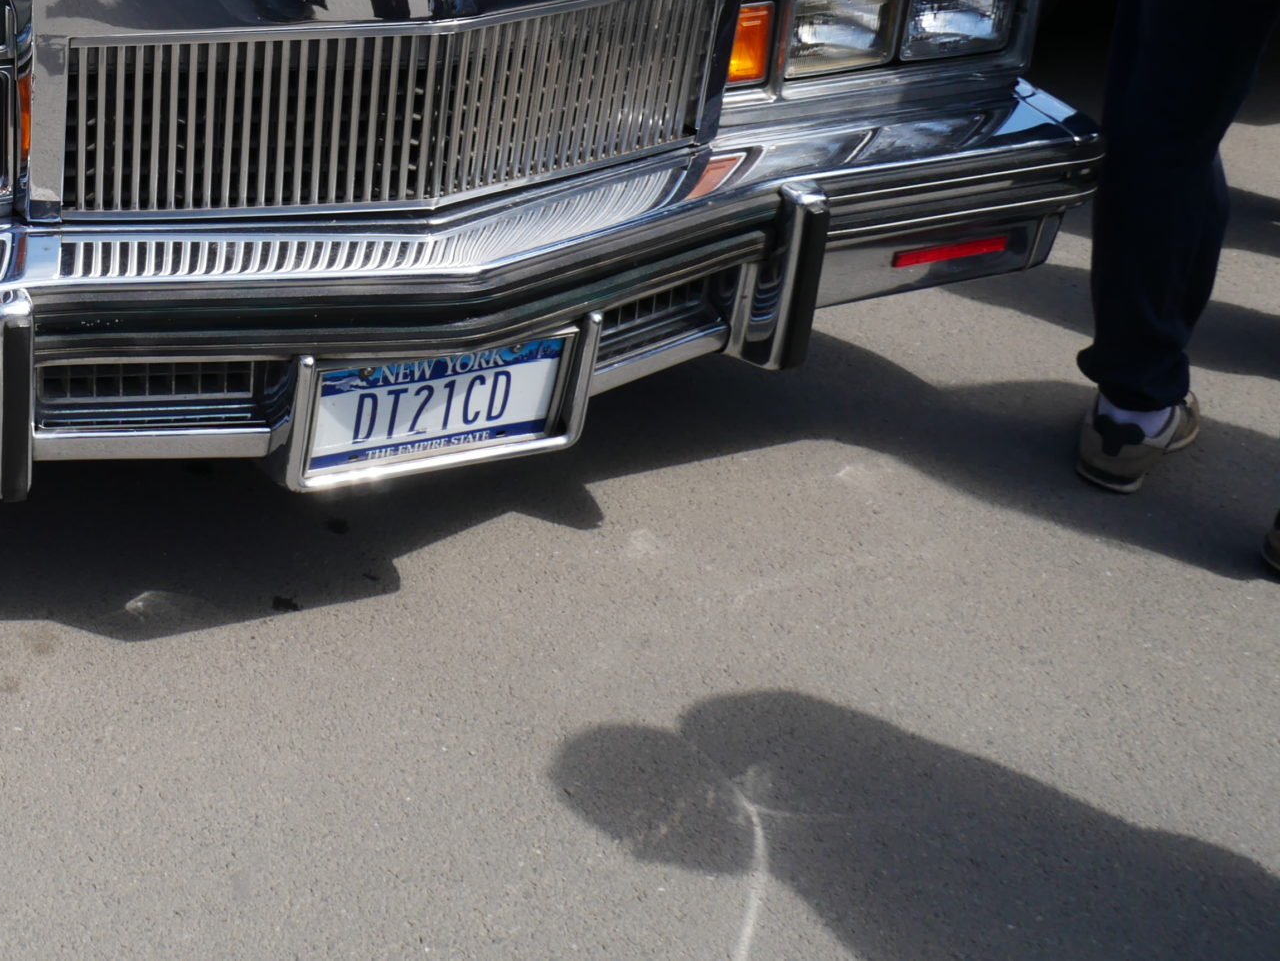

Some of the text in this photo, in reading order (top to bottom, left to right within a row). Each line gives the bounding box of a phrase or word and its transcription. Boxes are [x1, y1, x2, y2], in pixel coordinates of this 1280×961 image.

[379, 349, 504, 386] NEW YORK
[352, 370, 512, 445] DT21CD
[365, 430, 490, 460] THE EMPIRE STATE
